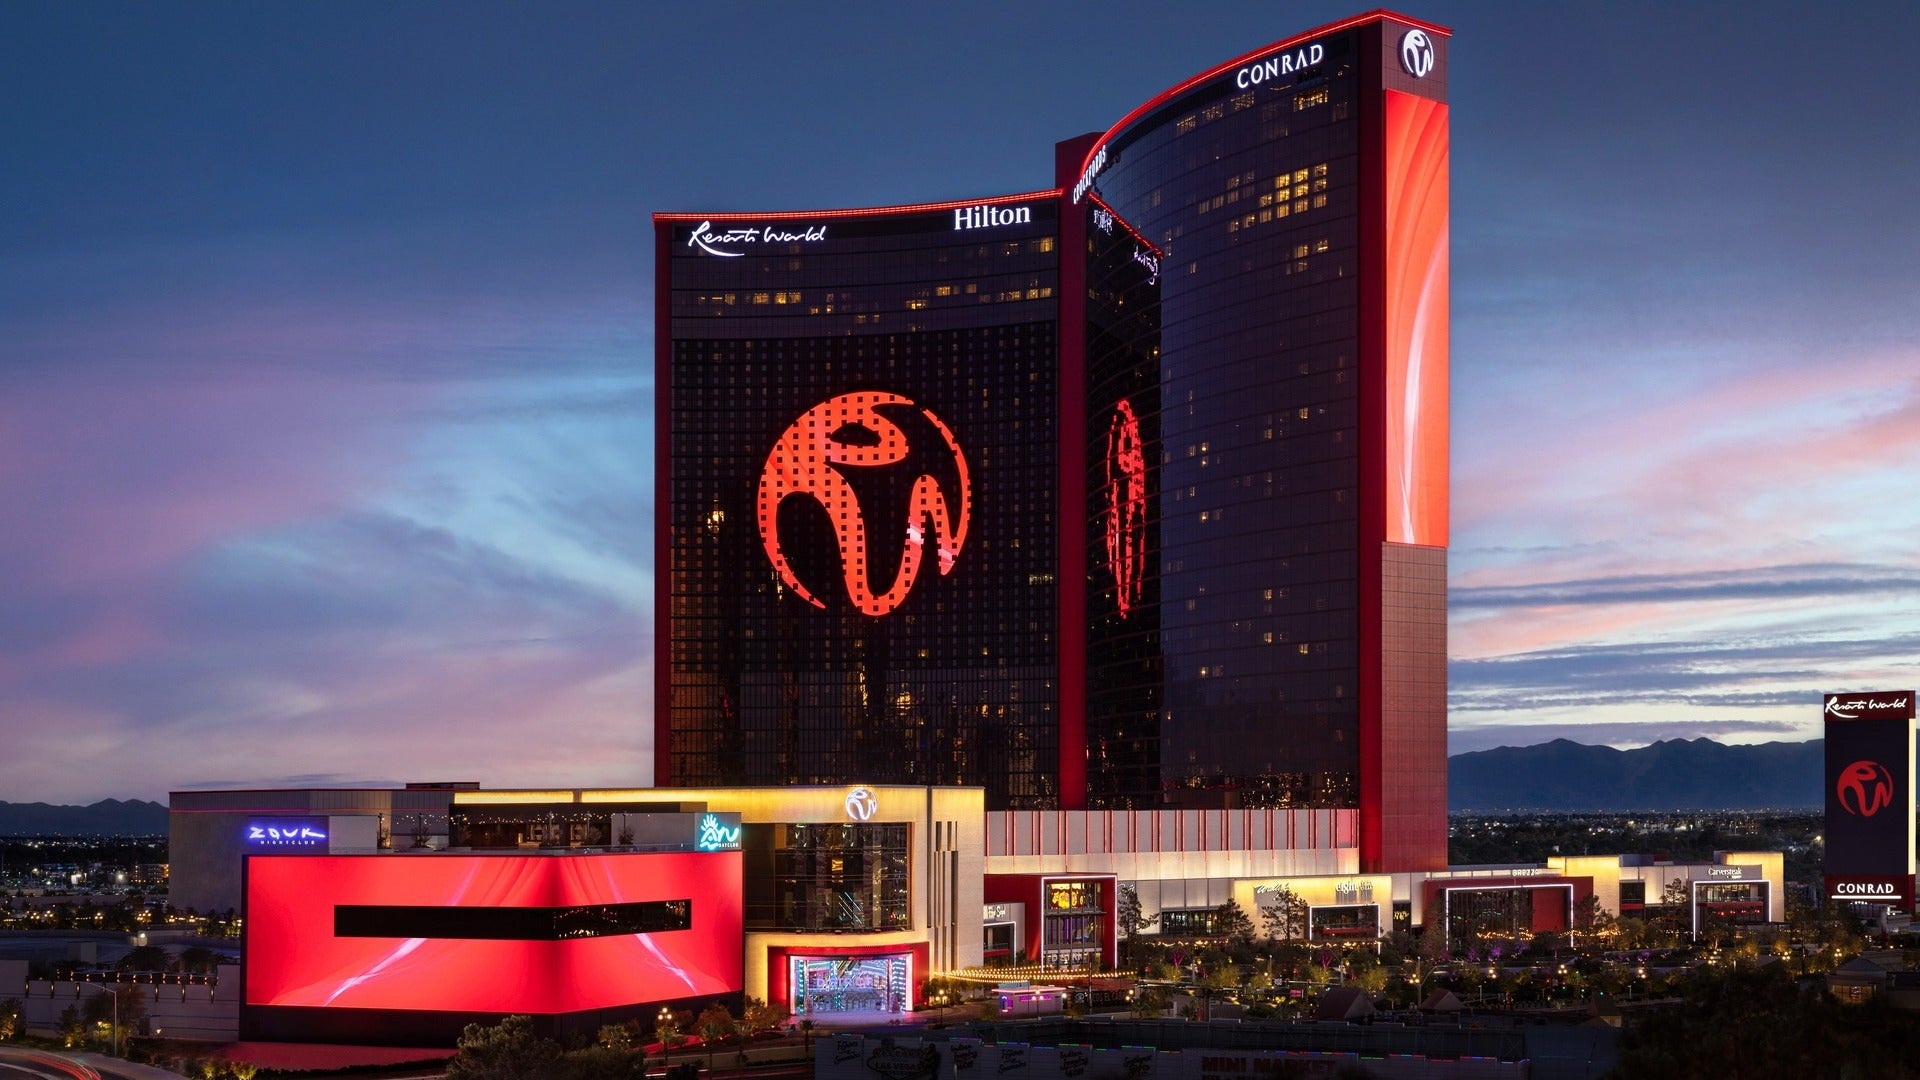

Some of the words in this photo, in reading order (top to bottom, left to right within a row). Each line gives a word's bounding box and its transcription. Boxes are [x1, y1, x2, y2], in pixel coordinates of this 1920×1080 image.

[1236, 44, 1324, 89] CONRAD
[954, 205, 1031, 230] Hilton
[688, 220, 760, 257] Resorts
[764, 225, 827, 243] World
[1825, 696, 1867, 718] Resorts
[1868, 698, 1907, 710] World
[1708, 867, 1743, 876] Carversteak
[1837, 883, 1895, 894] CONRAD
[1202, 1056, 1247, 1072] MINI
[1254, 1058, 1336, 1073] MARKET
